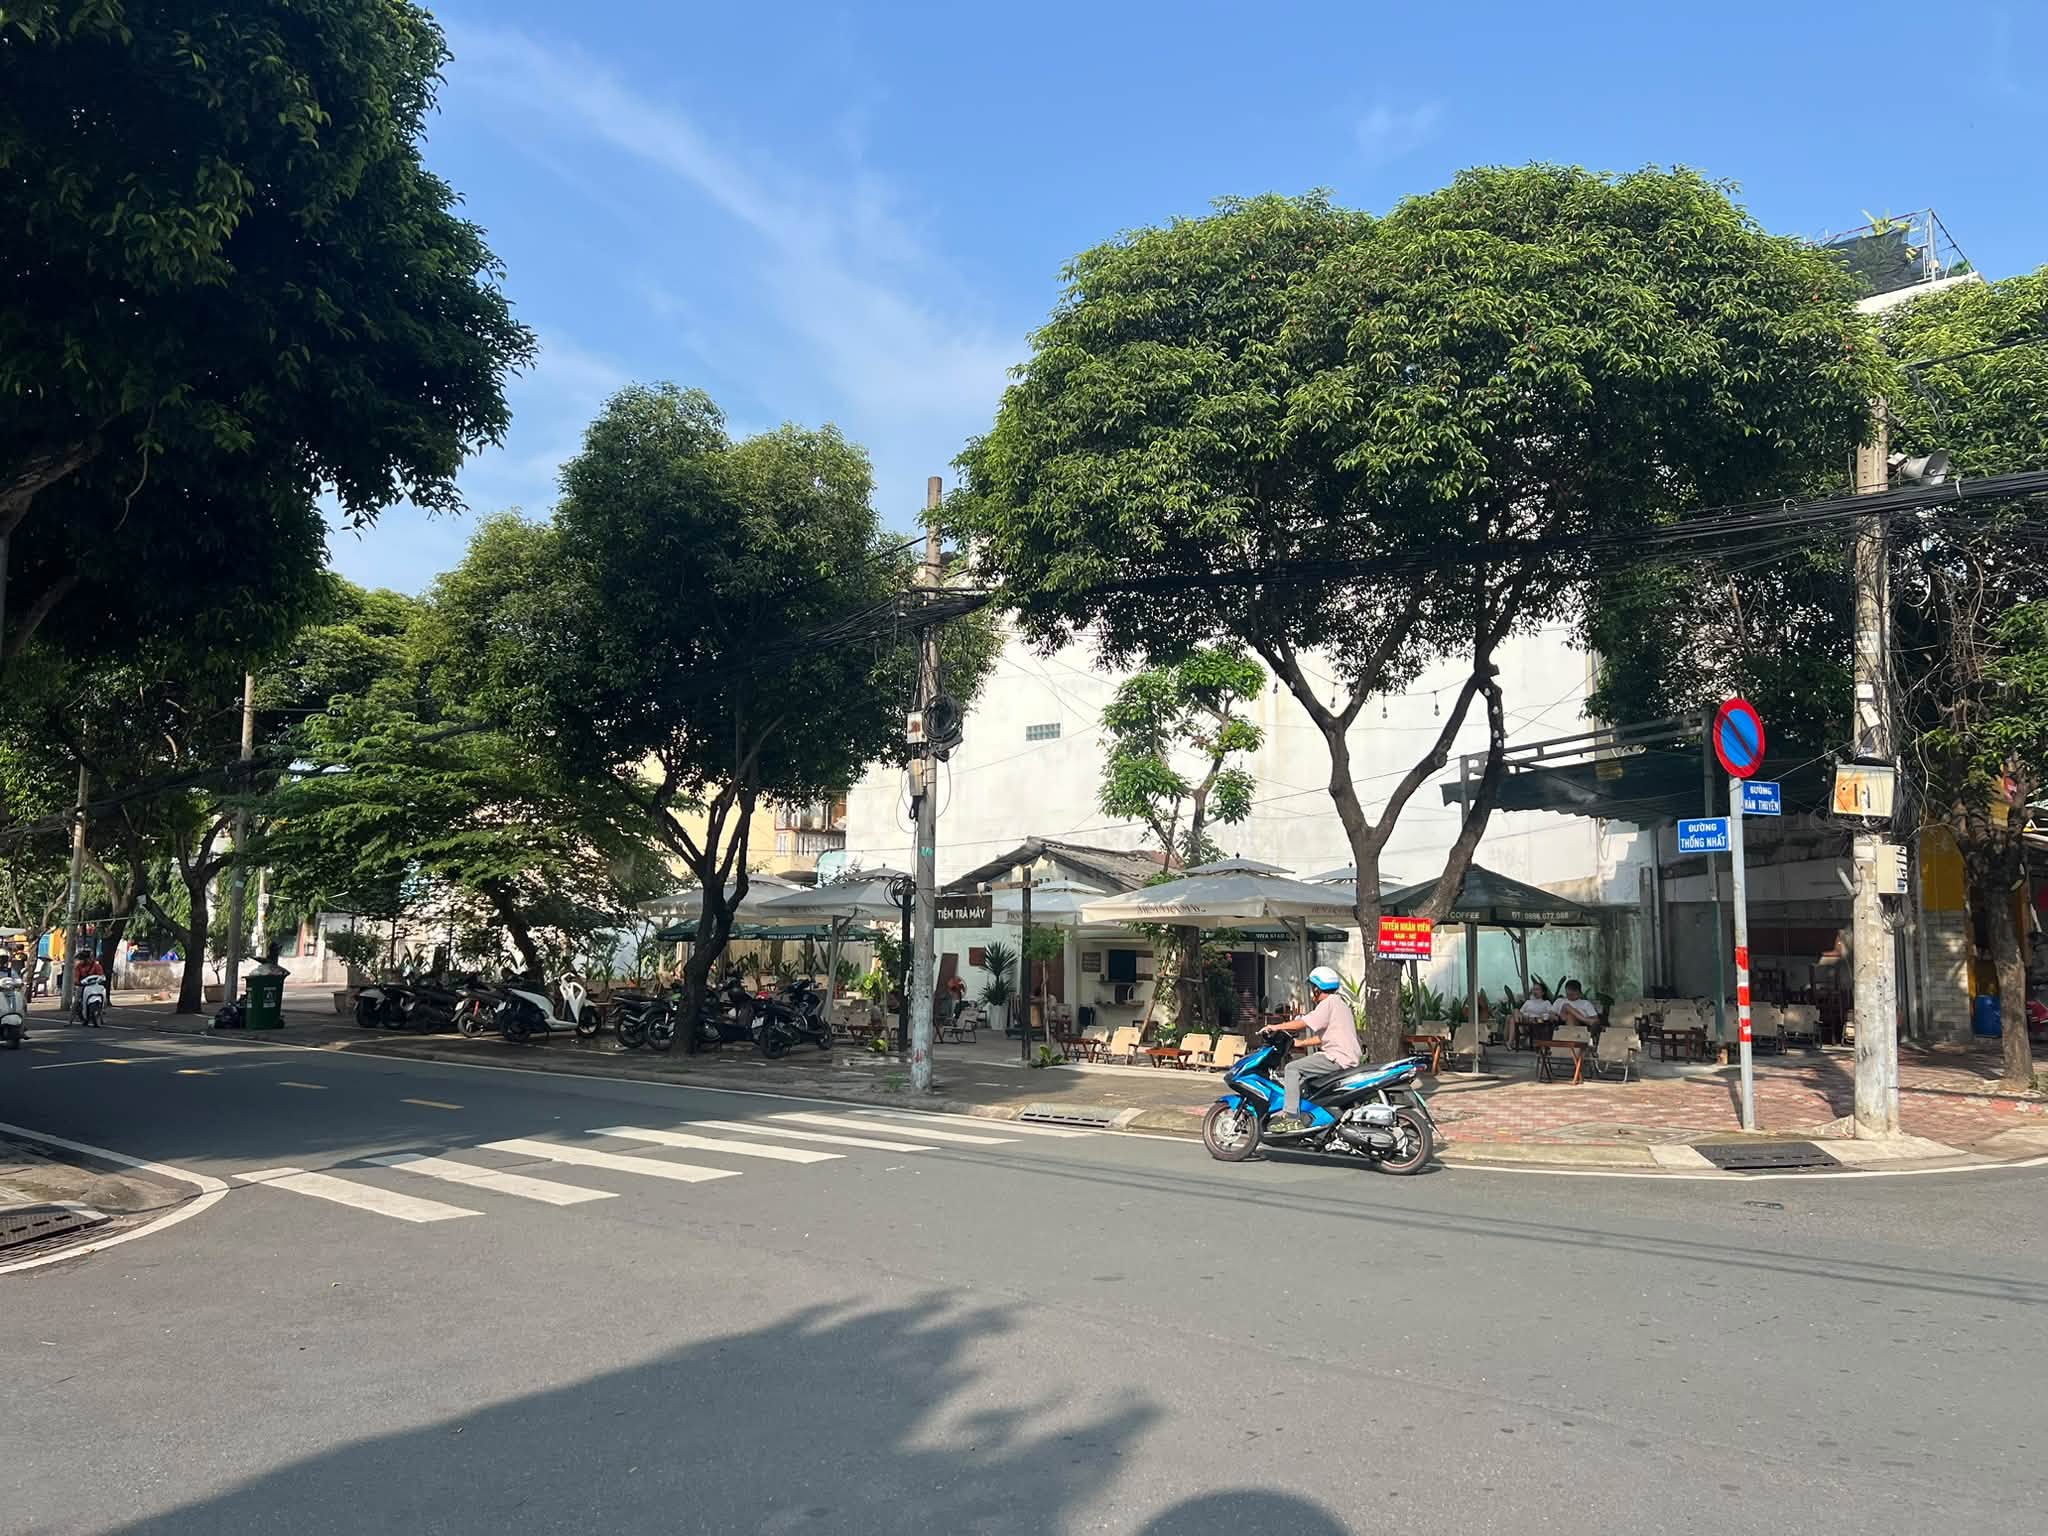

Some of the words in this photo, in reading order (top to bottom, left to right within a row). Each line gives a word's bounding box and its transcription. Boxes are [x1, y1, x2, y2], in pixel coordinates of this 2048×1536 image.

[1749, 784, 1773, 796] ĐƯỜNG
[1688, 822, 1717, 833] ĐƯỜNG
[1681, 834, 1705, 849] THỐNG
[1706, 832, 1726, 848] NHẤT
[1449, 911, 1481, 919] COFFEE
